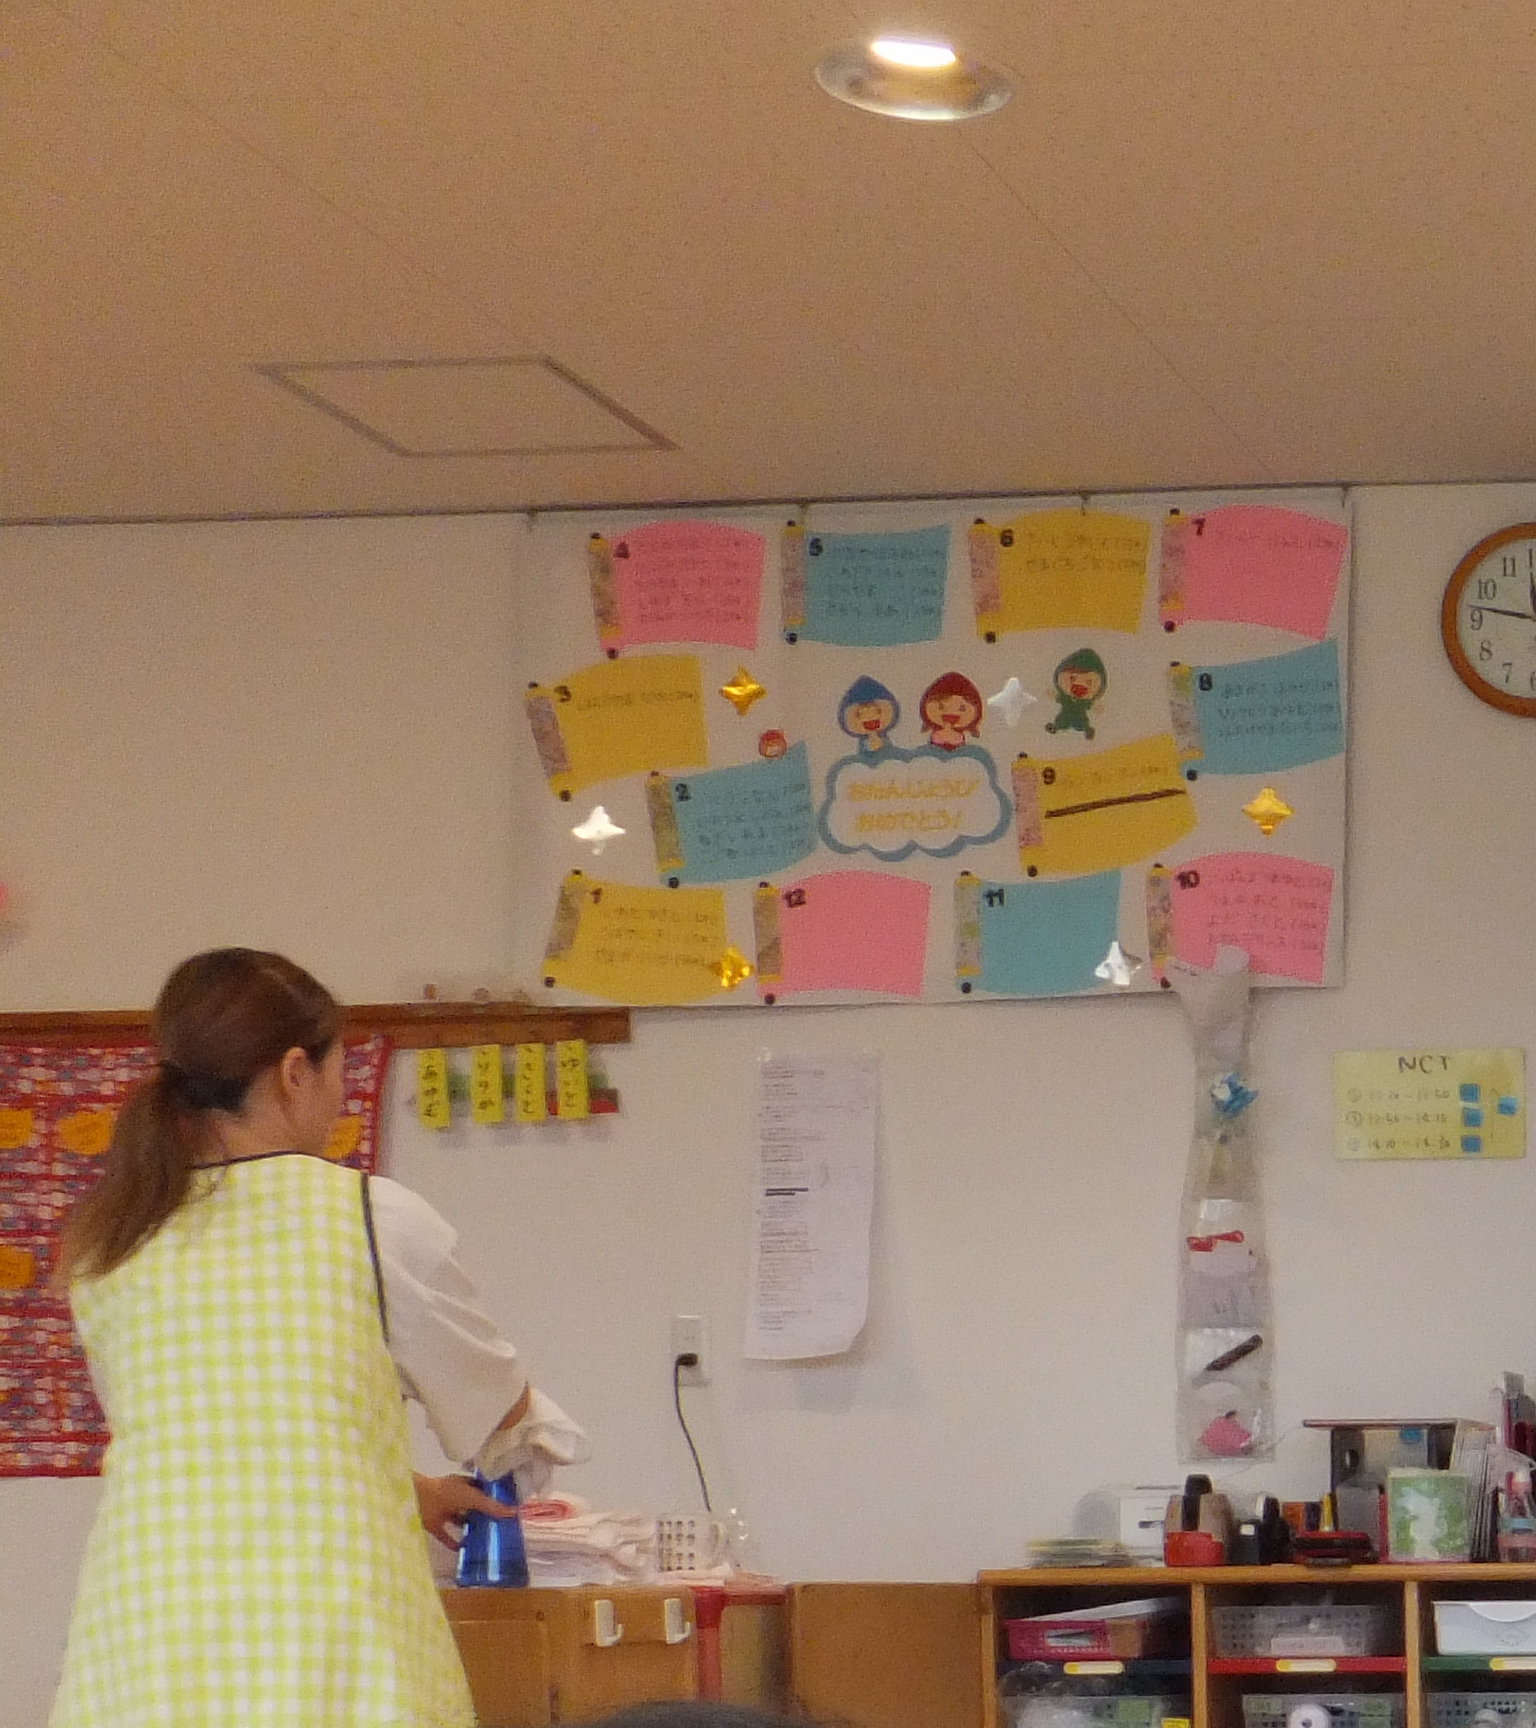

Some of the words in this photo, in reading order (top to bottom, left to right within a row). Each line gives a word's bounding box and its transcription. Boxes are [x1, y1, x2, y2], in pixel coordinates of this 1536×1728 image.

[1192, 518, 1206, 536] 7
[808, 537, 824, 556] 5
[999, 529, 1015, 548] 6
[614, 542, 630, 558] 4
[1503, 557, 1516, 577] 11
[1477, 579, 1497, 600] 10
[1470, 609, 1483, 631] 9
[1479, 640, 1492, 661] 8
[1199, 673, 1213, 691] 8
[1502, 663, 1513, 683] 7
[556, 686, 572, 702] 3
[1042, 768, 1056, 785] 9
[675, 783, 690, 801] 2
[1176, 871, 1199, 889] 10
[782, 888, 807, 907] 12
[984, 889, 1005, 907] 11
[1398, 1055, 1450, 1074] NCT
